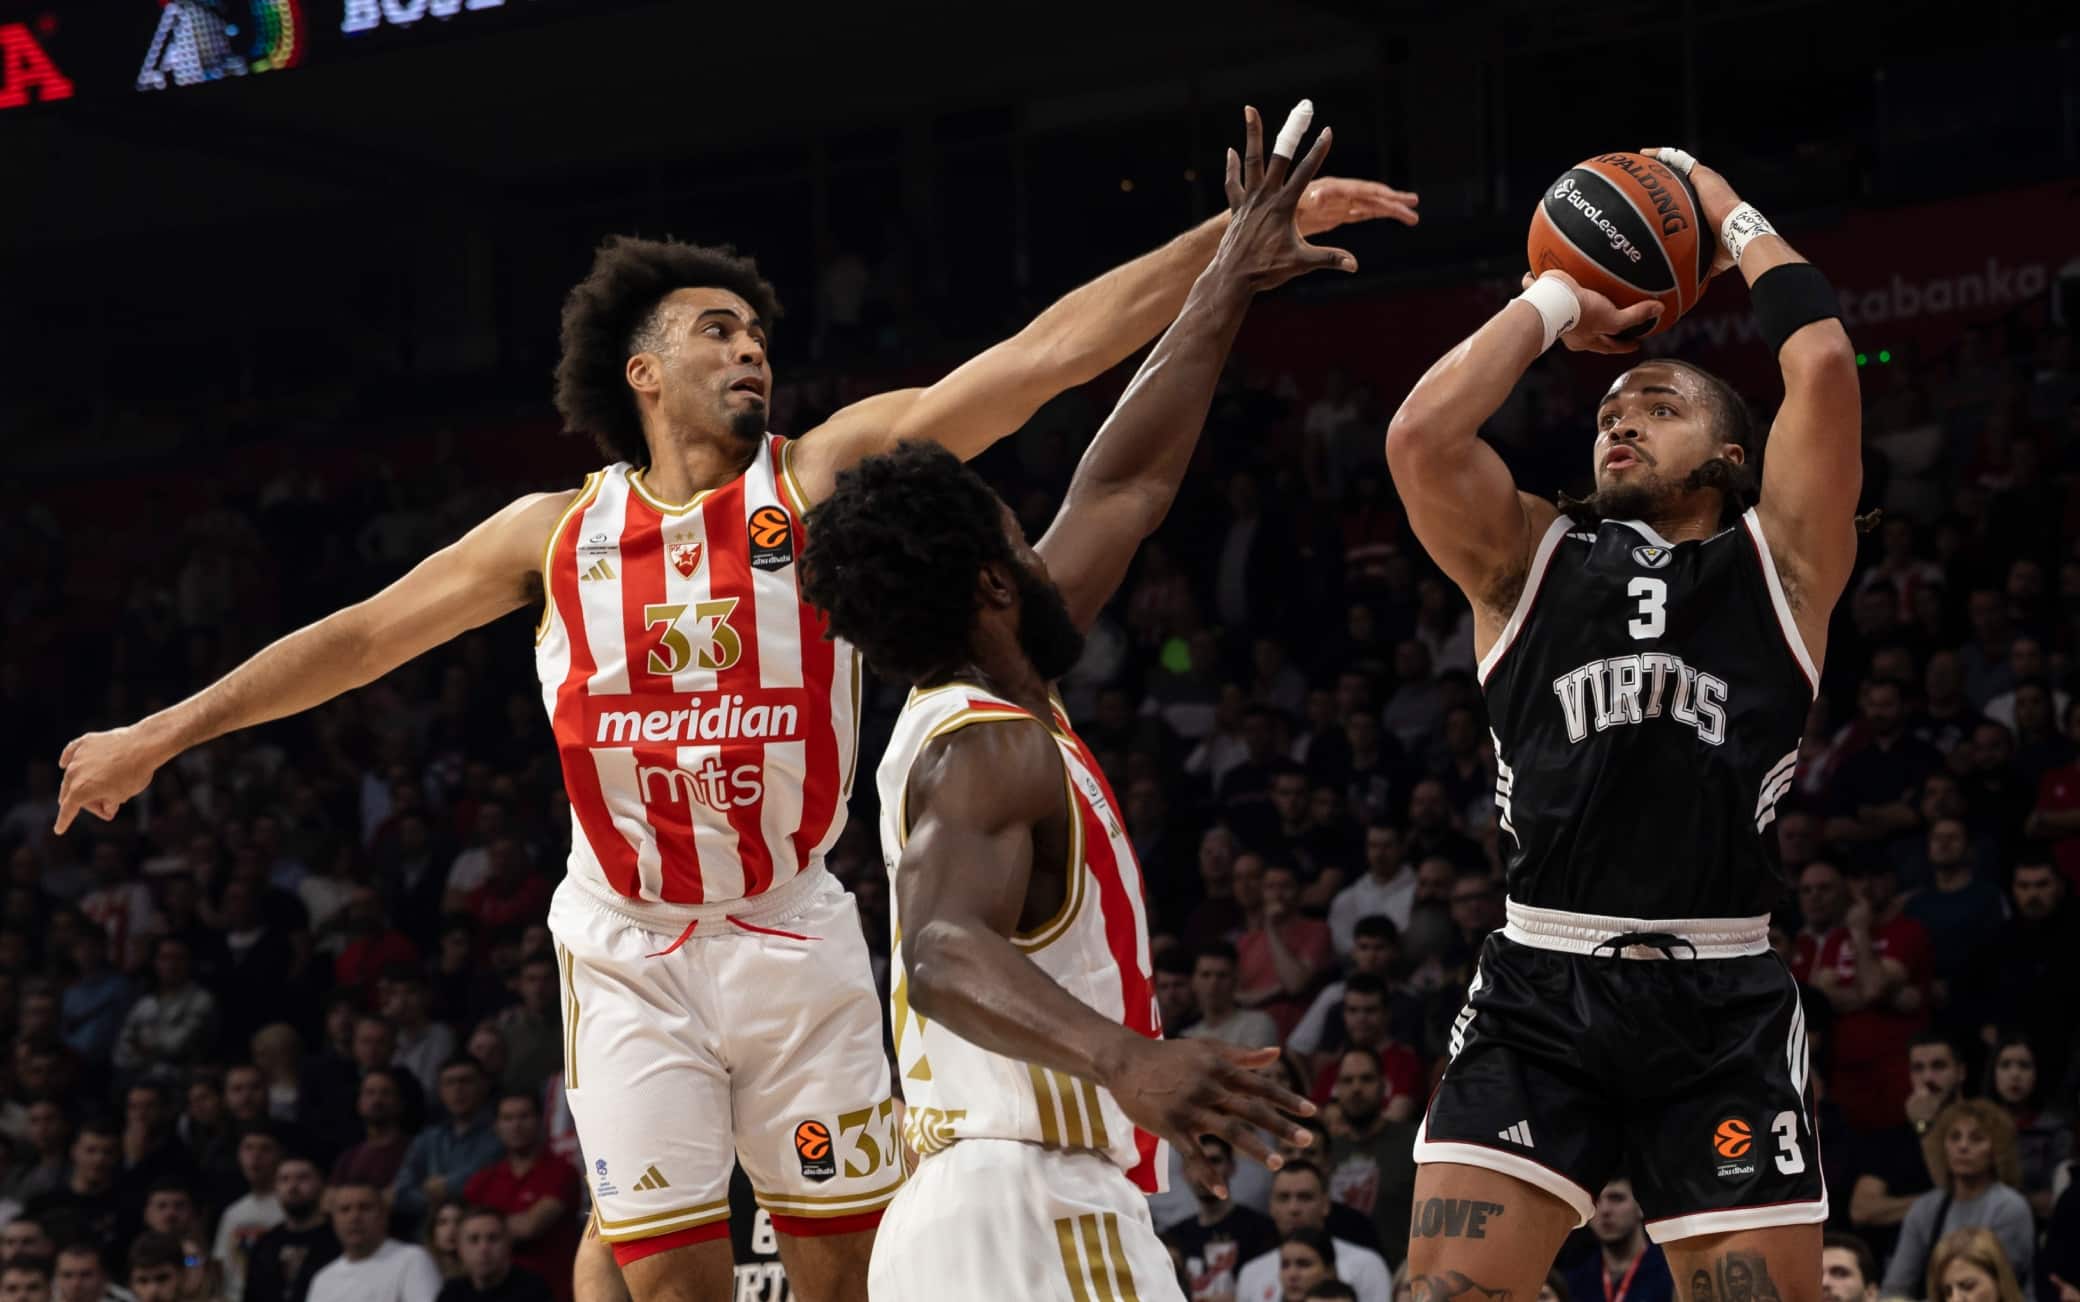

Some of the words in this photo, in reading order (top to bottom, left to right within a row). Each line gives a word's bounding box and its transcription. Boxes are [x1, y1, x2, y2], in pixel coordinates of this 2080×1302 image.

[1567, 190, 1642, 264] EuroLeague
[644, 596, 742, 676] 33
[1628, 576, 1668, 640] 3
[597, 694, 798, 743] meridian
[639, 758, 763, 811] mts
[1771, 1110, 1806, 1175] 3
